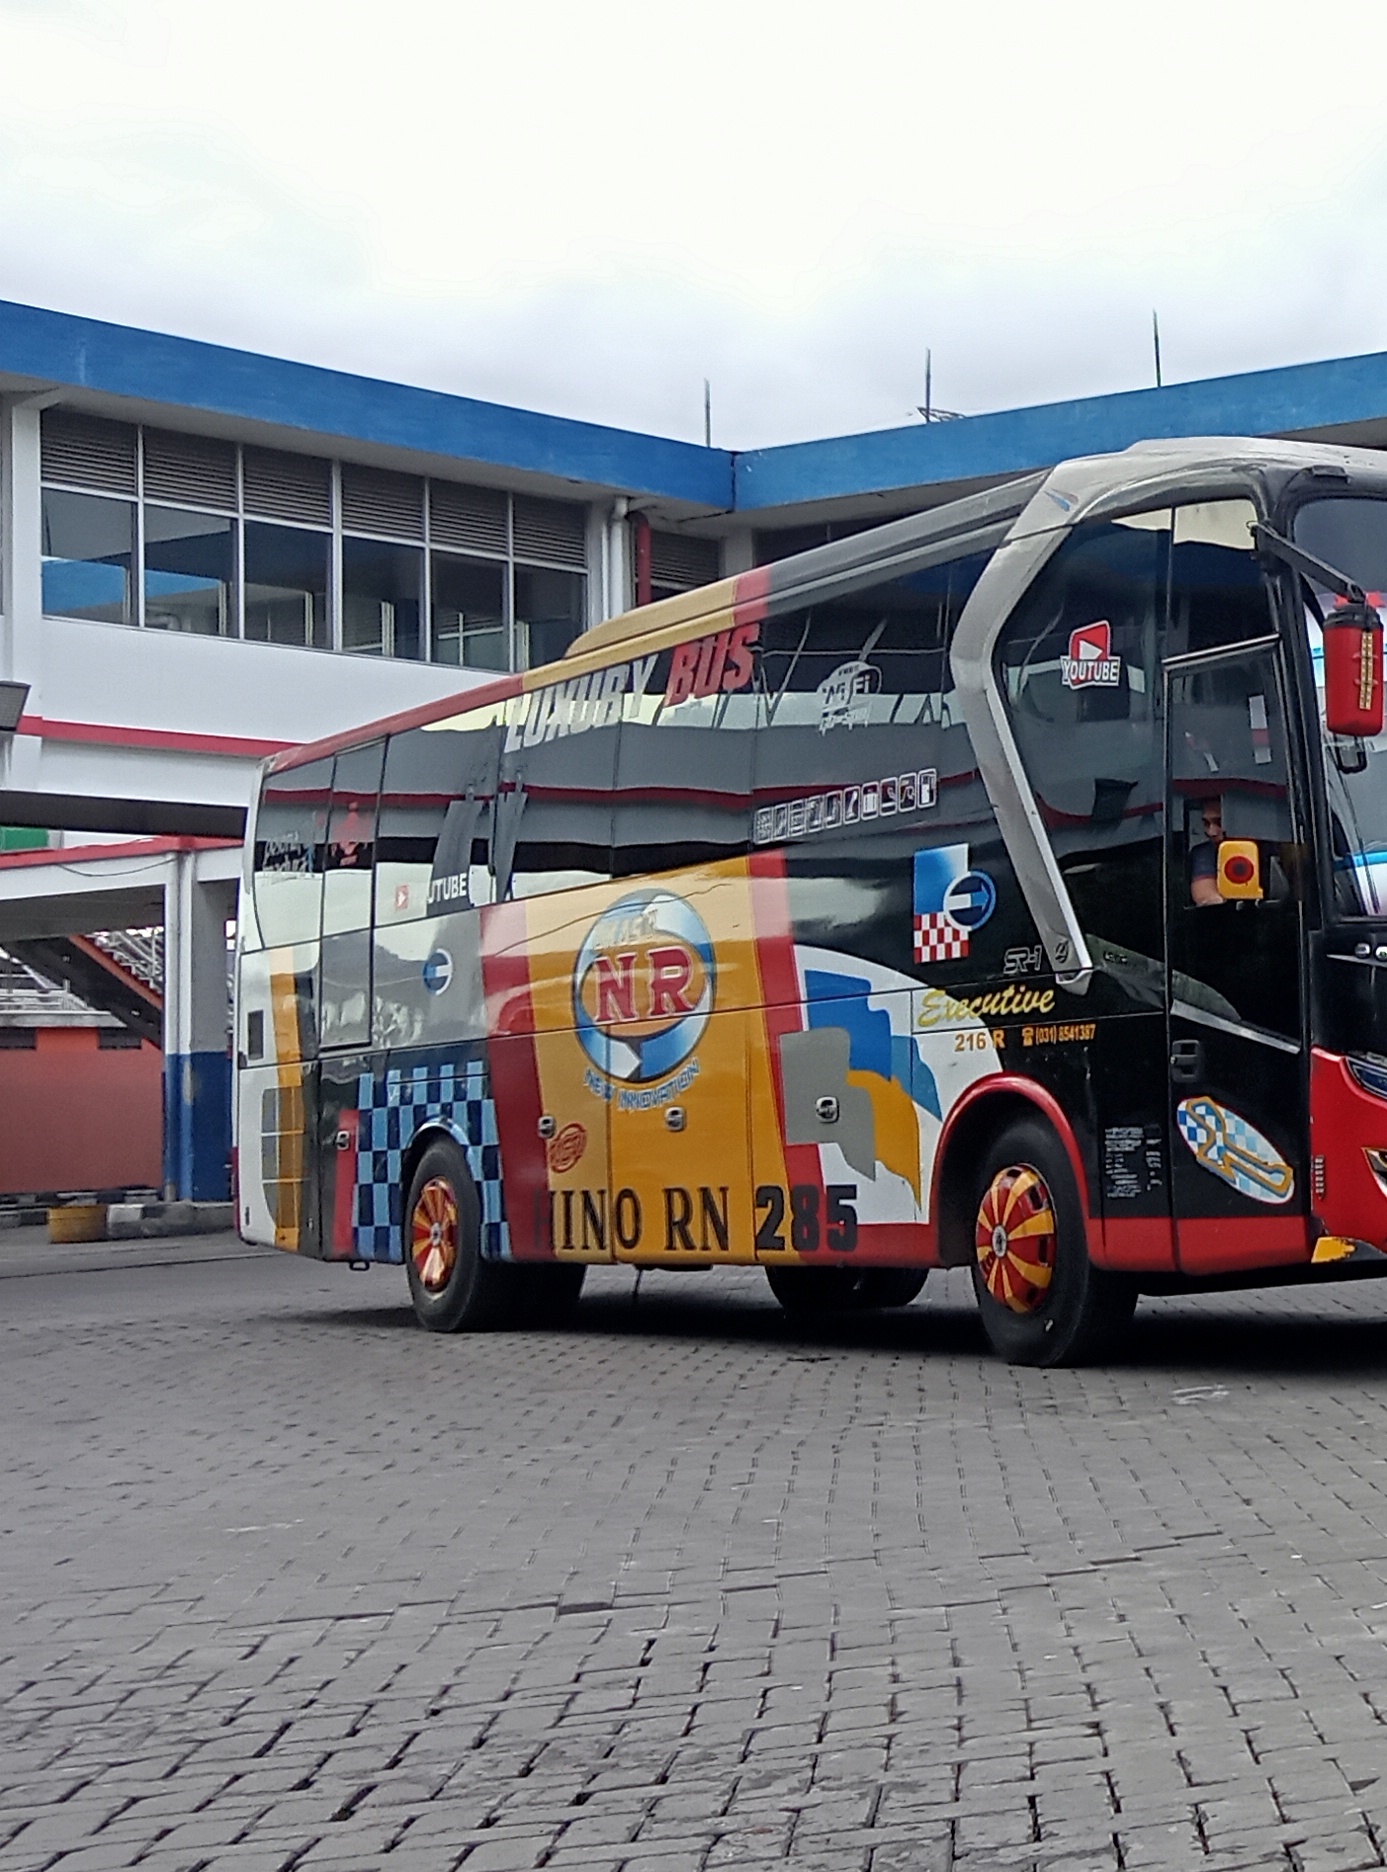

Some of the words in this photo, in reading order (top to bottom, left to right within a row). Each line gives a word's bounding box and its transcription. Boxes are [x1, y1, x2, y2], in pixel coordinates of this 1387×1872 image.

[664, 622, 760, 708] BUS
[1063, 660, 1119, 682] YOUTUBE
[593, 946, 695, 1024] NR
[917, 984, 1056, 1028] Executive
[955, 1032, 987, 1052] 216
[992, 1029, 1006, 1049] R
[1035, 1025, 1057, 1045] (031)
[533, 1187, 644, 1251] HINO
[663, 1186, 730, 1251] RN
[755, 1184, 858, 1253] 285
